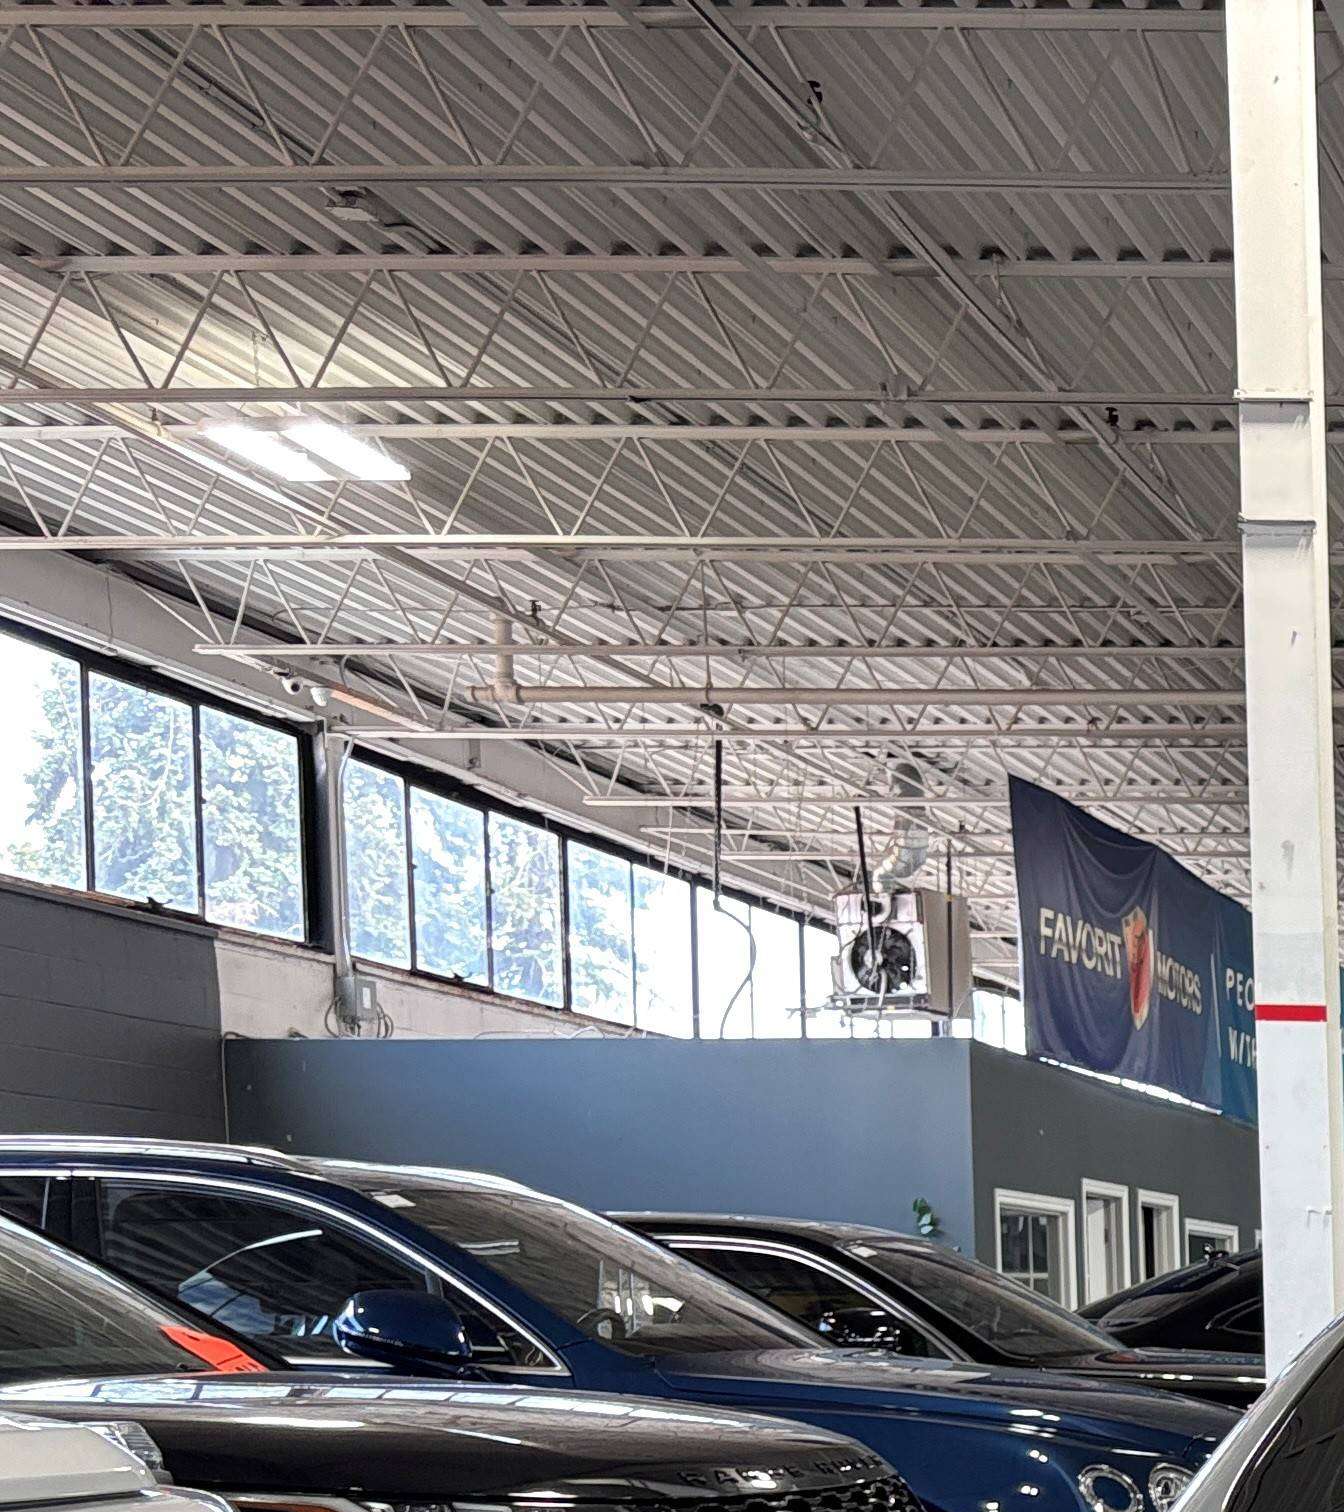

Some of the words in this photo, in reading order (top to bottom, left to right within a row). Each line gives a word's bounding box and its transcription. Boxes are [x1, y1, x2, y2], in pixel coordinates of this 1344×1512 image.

[1039, 907, 1122, 979] FAVORIT
[1153, 951, 1203, 1015] MOTORS
[1225, 967, 1255, 1011] PEO
